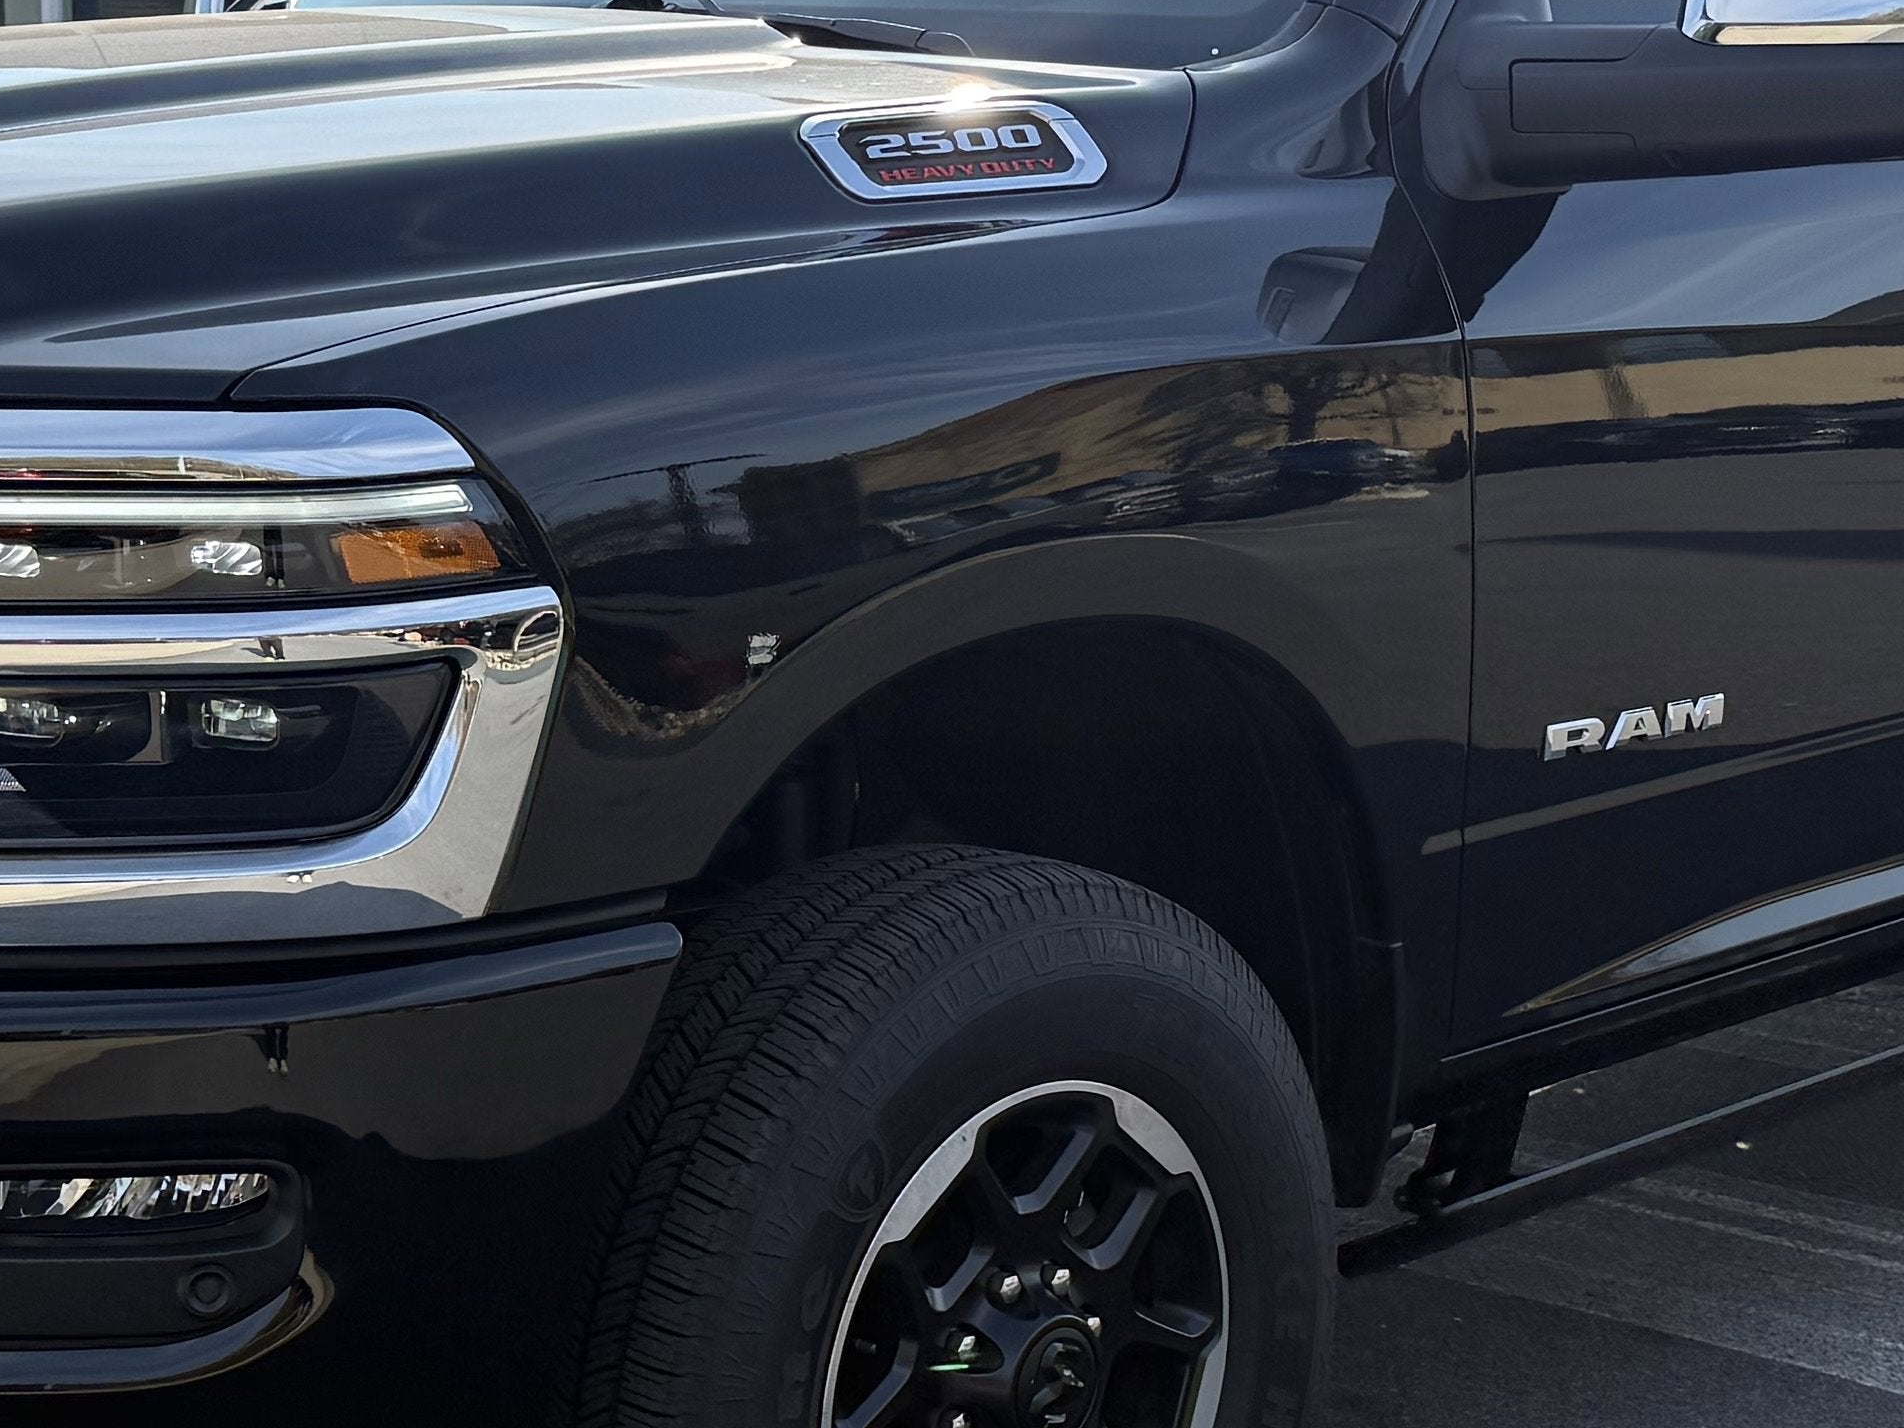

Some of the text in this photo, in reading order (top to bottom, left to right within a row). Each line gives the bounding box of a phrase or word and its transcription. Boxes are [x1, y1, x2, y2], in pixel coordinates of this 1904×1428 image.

[858, 123, 1042, 159] 2500
[879, 158, 1056, 182] HEAVY DUTY
[1544, 693, 1724, 761] RAM
